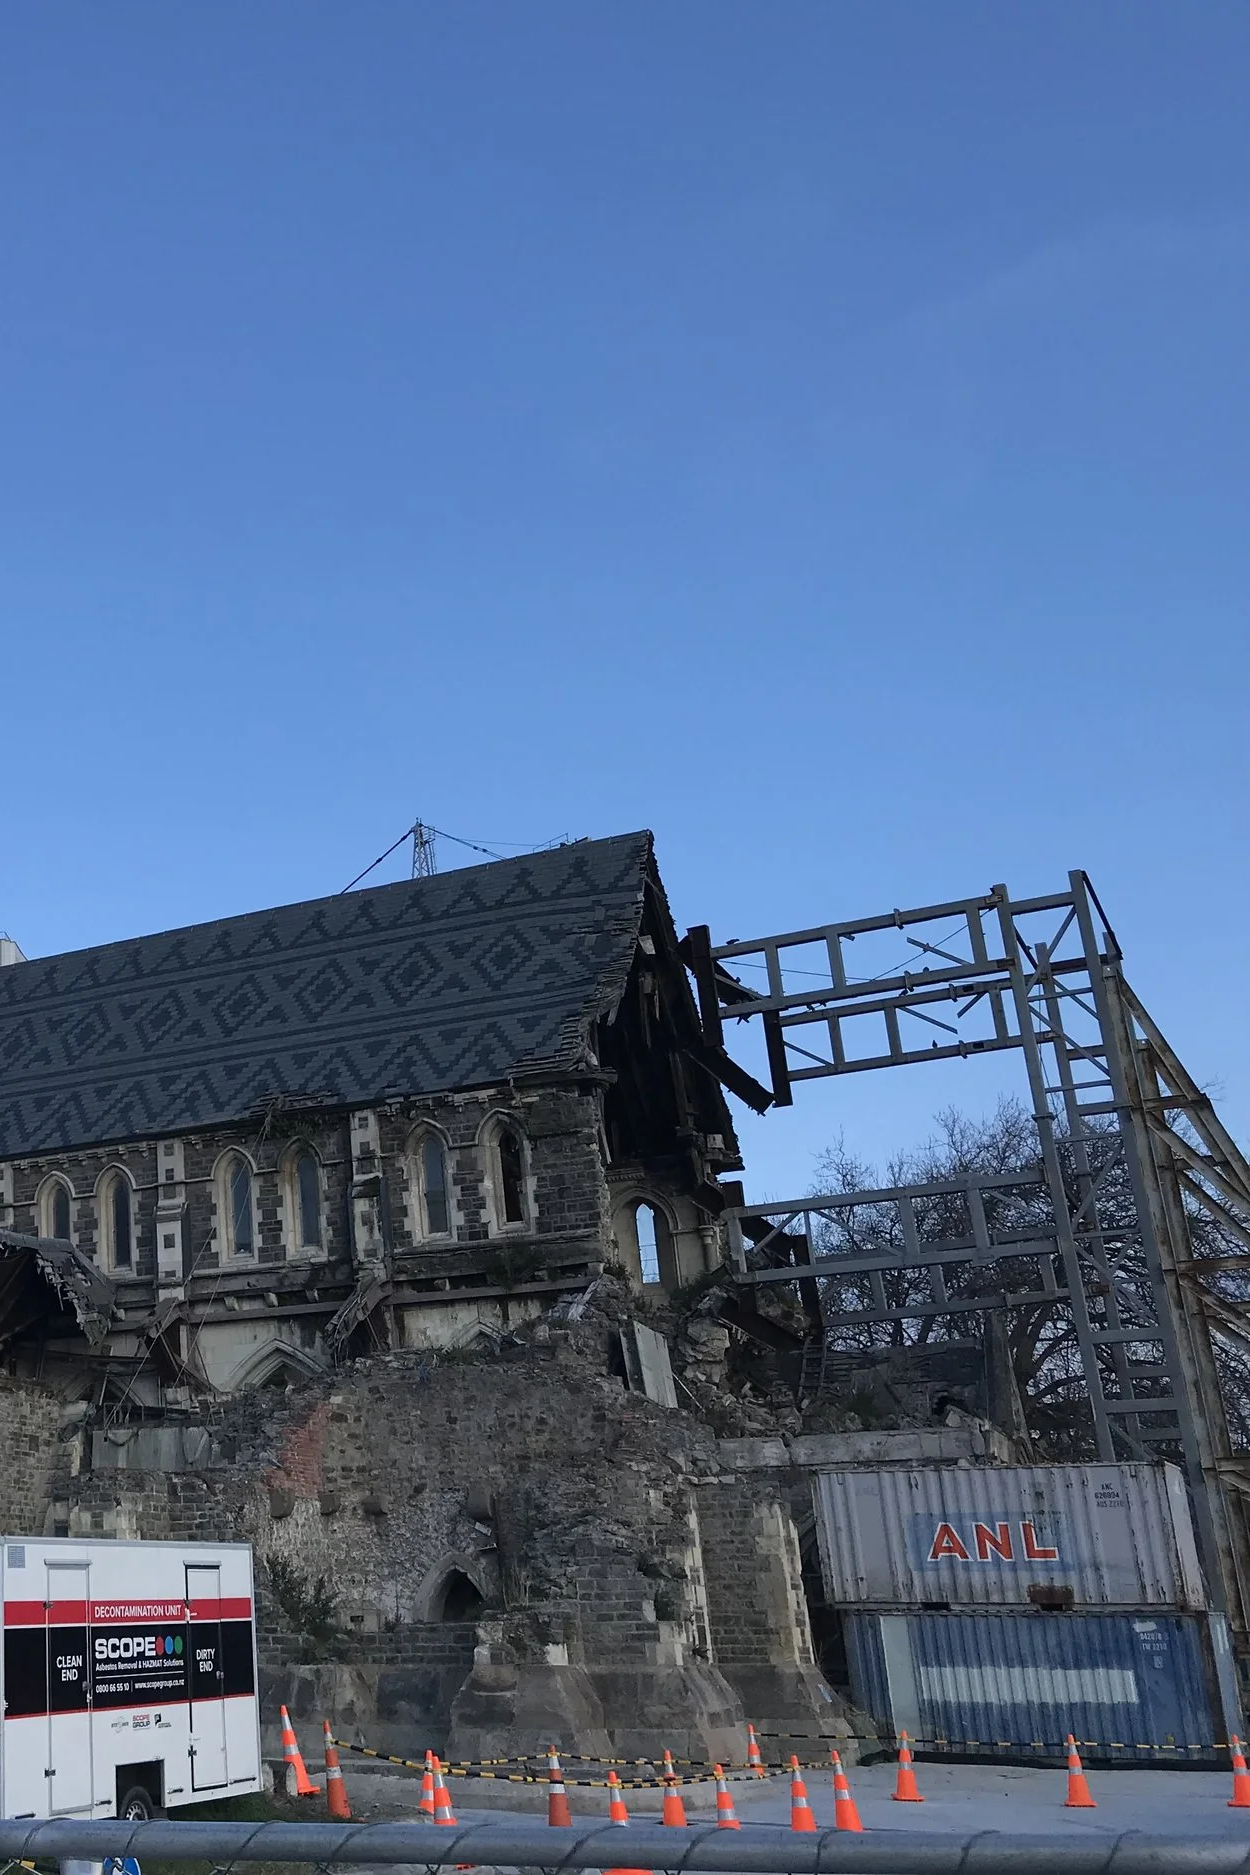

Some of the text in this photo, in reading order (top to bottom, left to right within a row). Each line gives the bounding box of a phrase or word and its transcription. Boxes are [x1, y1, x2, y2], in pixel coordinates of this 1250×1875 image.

[927, 1520, 1060, 1562] ANL
[94, 1604, 182, 1618] DECONTAMINATION UNIT
[95, 1636, 157, 1659] SCOPE
[196, 1648, 215, 1660] DIRTY
[56, 1655, 82, 1668] CLEAN
[95, 1662, 117, 1671] Asbestos
[200, 1661, 213, 1672] END
[61, 1668, 78, 1681] END
[95, 1684, 109, 1693] 0800
[109, 1683, 116, 1692] 66
[116, 1682, 124, 1692] 55
[124, 1682, 130, 1691] 10
[132, 1713, 150, 1721] SCOPE
[132, 1721, 151, 1729] GROUP
